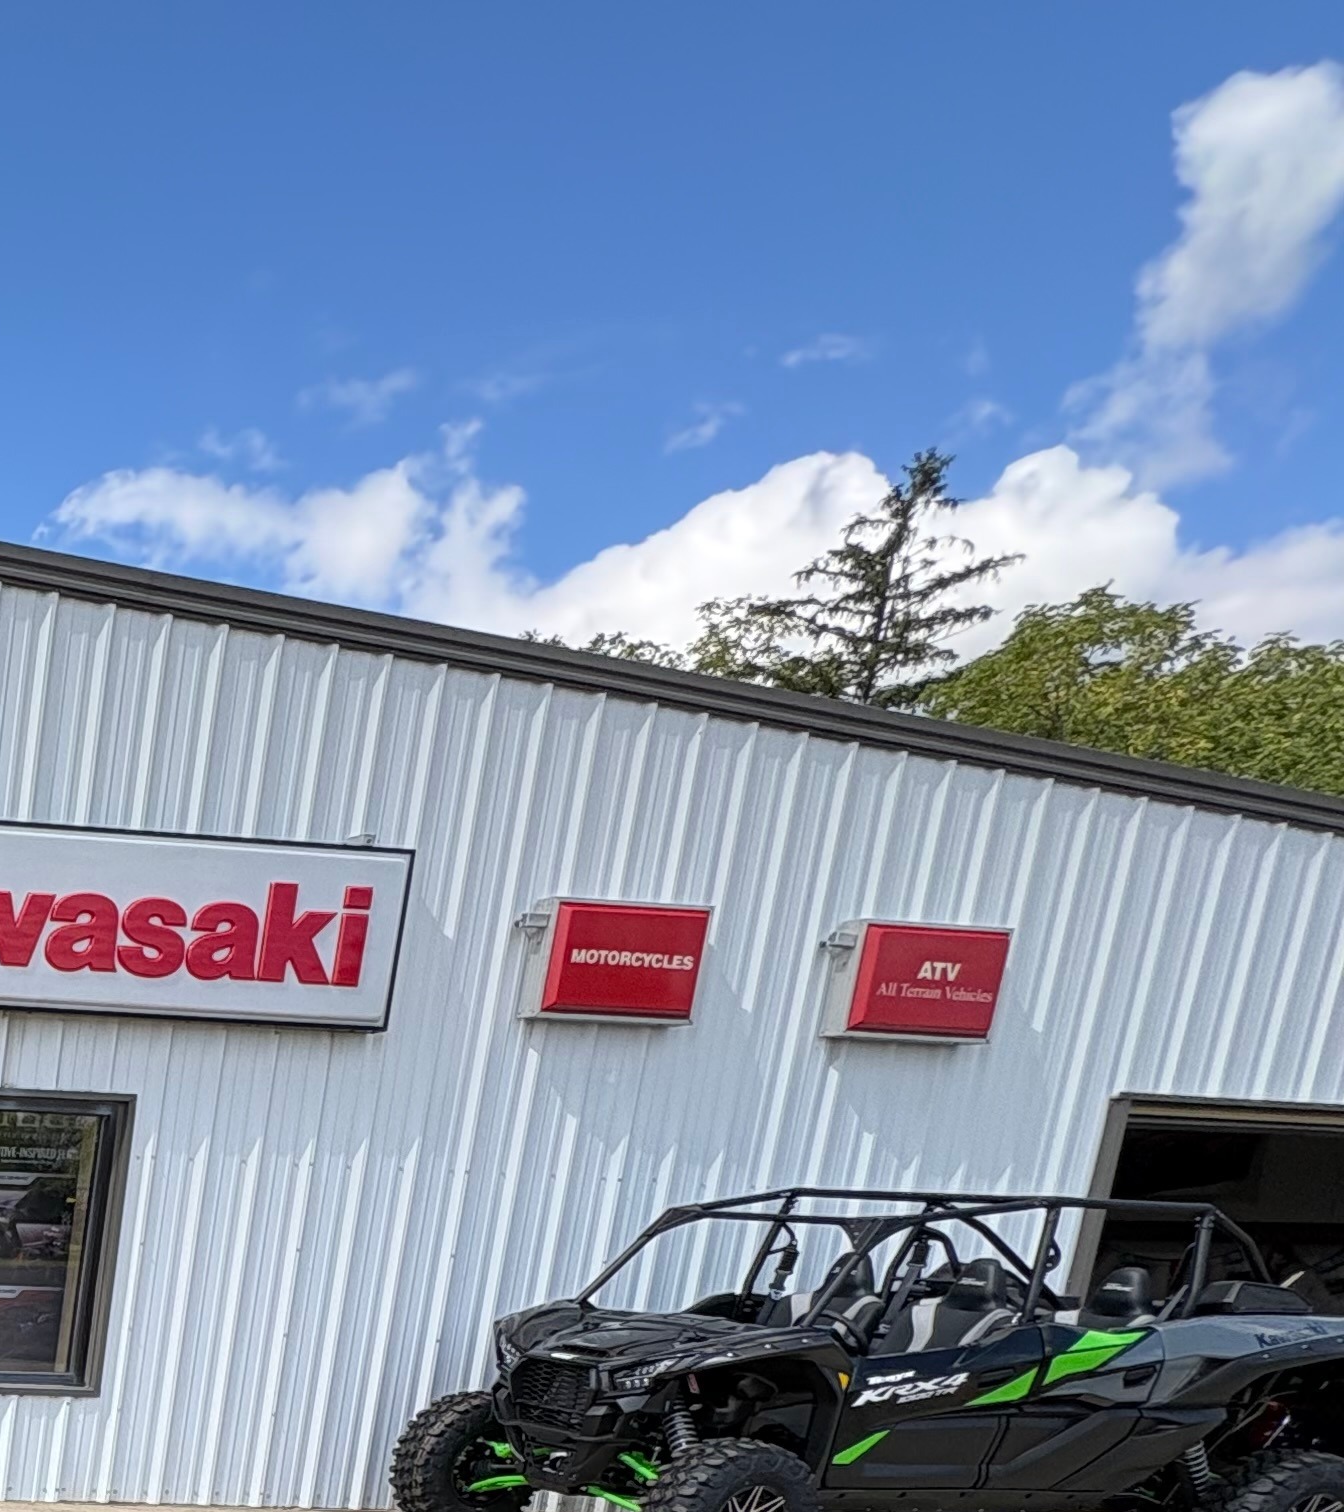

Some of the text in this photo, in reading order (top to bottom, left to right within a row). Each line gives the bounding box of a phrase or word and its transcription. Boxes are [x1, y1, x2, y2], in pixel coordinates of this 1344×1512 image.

[571, 949, 694, 970] MOTORCYCLES
[917, 961, 962, 981] ATV
[876, 982, 993, 1003] All Terrain Vehicles
